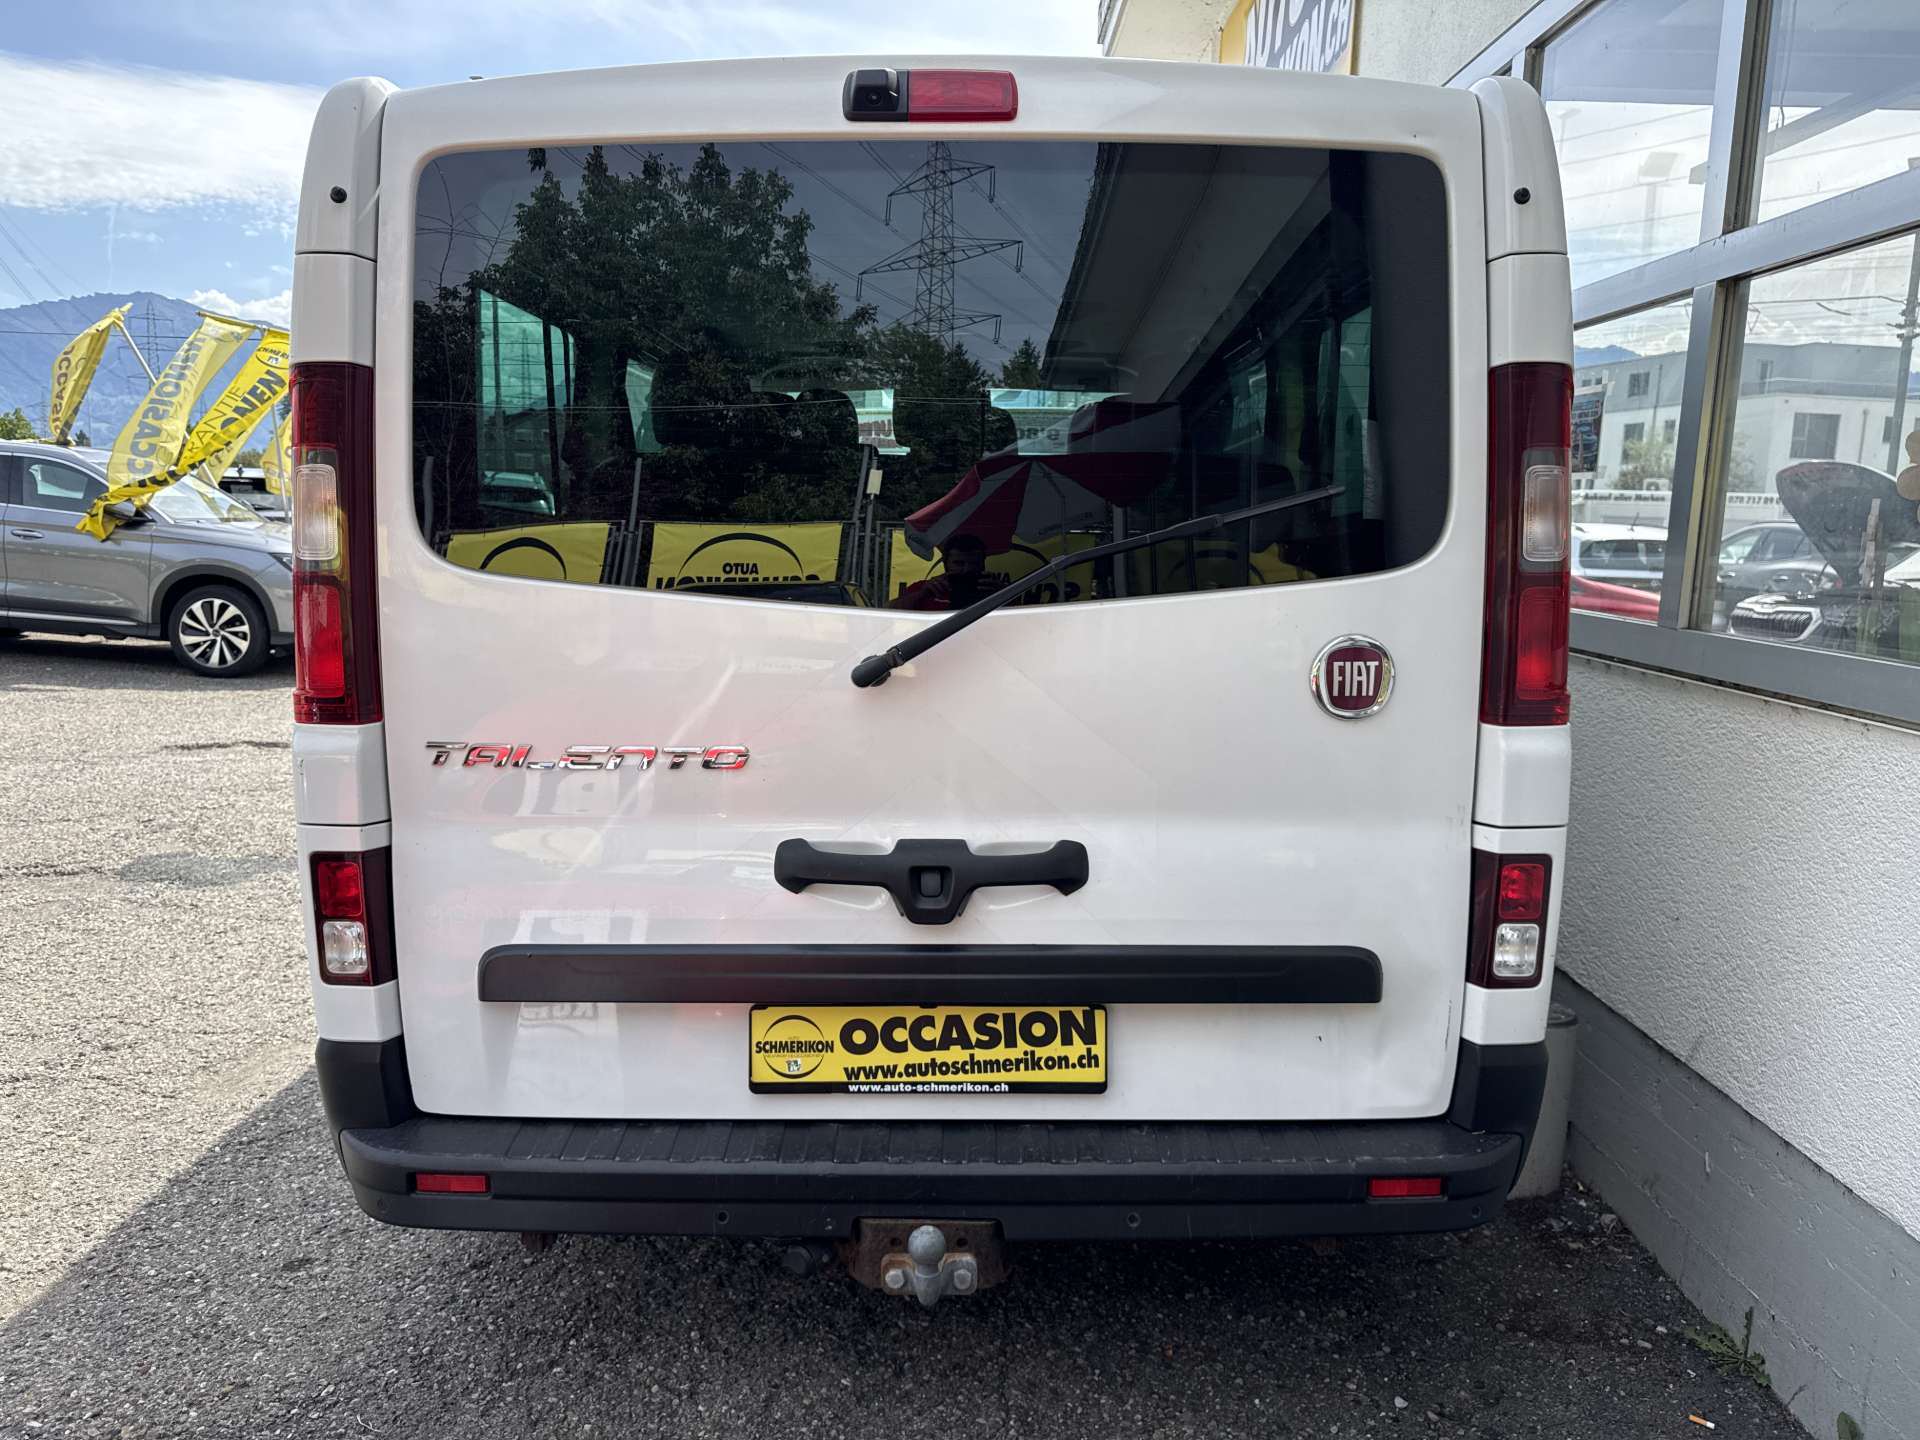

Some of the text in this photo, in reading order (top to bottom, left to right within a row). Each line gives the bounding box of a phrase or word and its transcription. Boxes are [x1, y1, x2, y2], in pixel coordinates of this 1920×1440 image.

[1332, 661, 1379, 697] FIAT
[425, 740, 751, 770] TALENTO
[755, 1040, 834, 1054] SCHMERIKON
[839, 1010, 1097, 1055] OCCASION
[843, 1047, 1100, 1081] www.autoschmerikon.ch
[848, 1082, 1009, 1092] www.auto-schmerikon.ch
